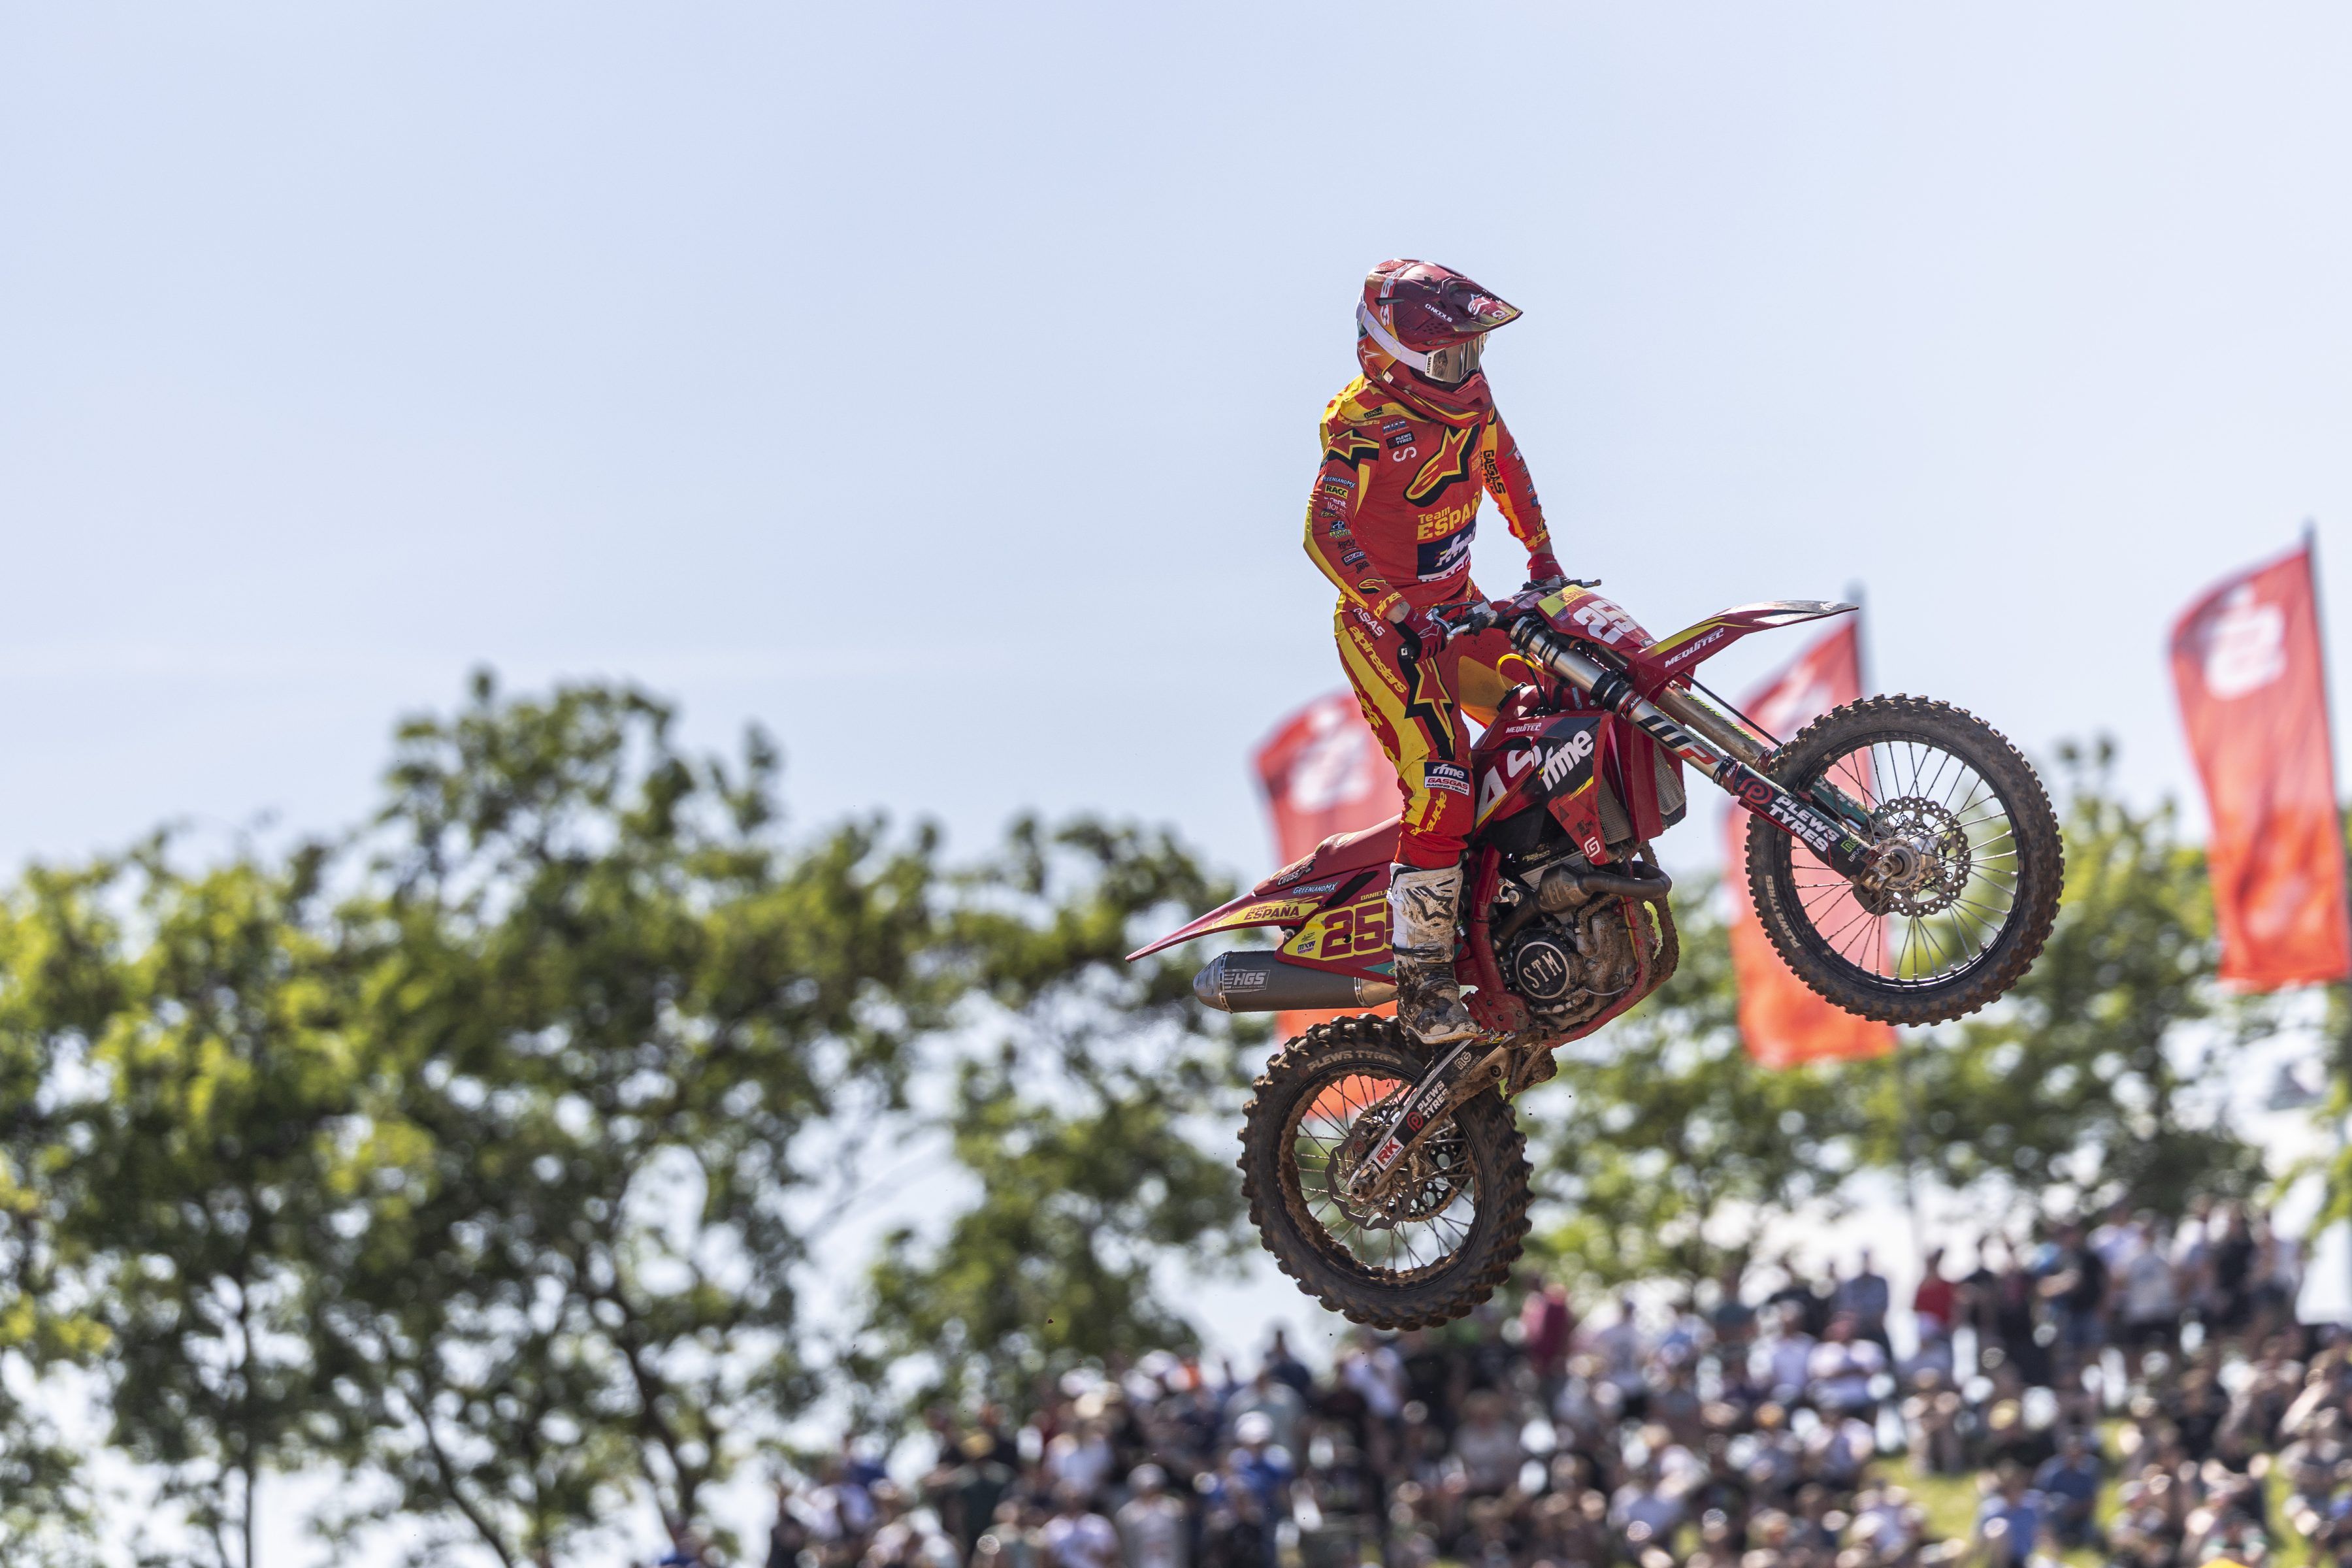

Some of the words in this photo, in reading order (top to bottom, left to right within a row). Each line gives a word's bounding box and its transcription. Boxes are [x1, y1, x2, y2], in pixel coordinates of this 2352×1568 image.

[1383, 418, 1406, 433] HGS
[1396, 433, 1411, 441] PLEWS
[1396, 436, 1413, 445] TYRES
[1323, 476, 1356, 489] REENLANDMX
[1326, 485, 1347, 497] RACC
[1417, 492, 1482, 540] ESPAÑ
[1418, 506, 1450, 524] Team
[1349, 626, 1407, 693] alpinestars
[1665, 630, 1724, 668] MEQUITEC
[1505, 723, 1541, 734] MEQUITEC
[1432, 764, 1465, 779] rfme
[1542, 730, 1594, 792] rfme
[1427, 777, 1469, 789] GASGAS
[1769, 804, 1829, 852] TYRES
[1774, 795, 1840, 842] PLEWS
[1293, 881, 1338, 894] GREENLANDMX
[1765, 875, 1780, 912] TYRES
[1244, 904, 1299, 921] ESPAÑA
[1776, 912, 1801, 949] PLEWS
[1233, 972, 1266, 985] HGS
[1523, 951, 1563, 989] STM
[1307, 1051, 1353, 1073] PLEWS
[1355, 1050, 1402, 1065] TYRES
[1459, 1054, 1481, 1078] BRAKES
[1416, 1080, 1445, 1113] PLEWS
[1422, 1088, 1450, 1119] TYRES
[1376, 1138, 1400, 1165] RK
